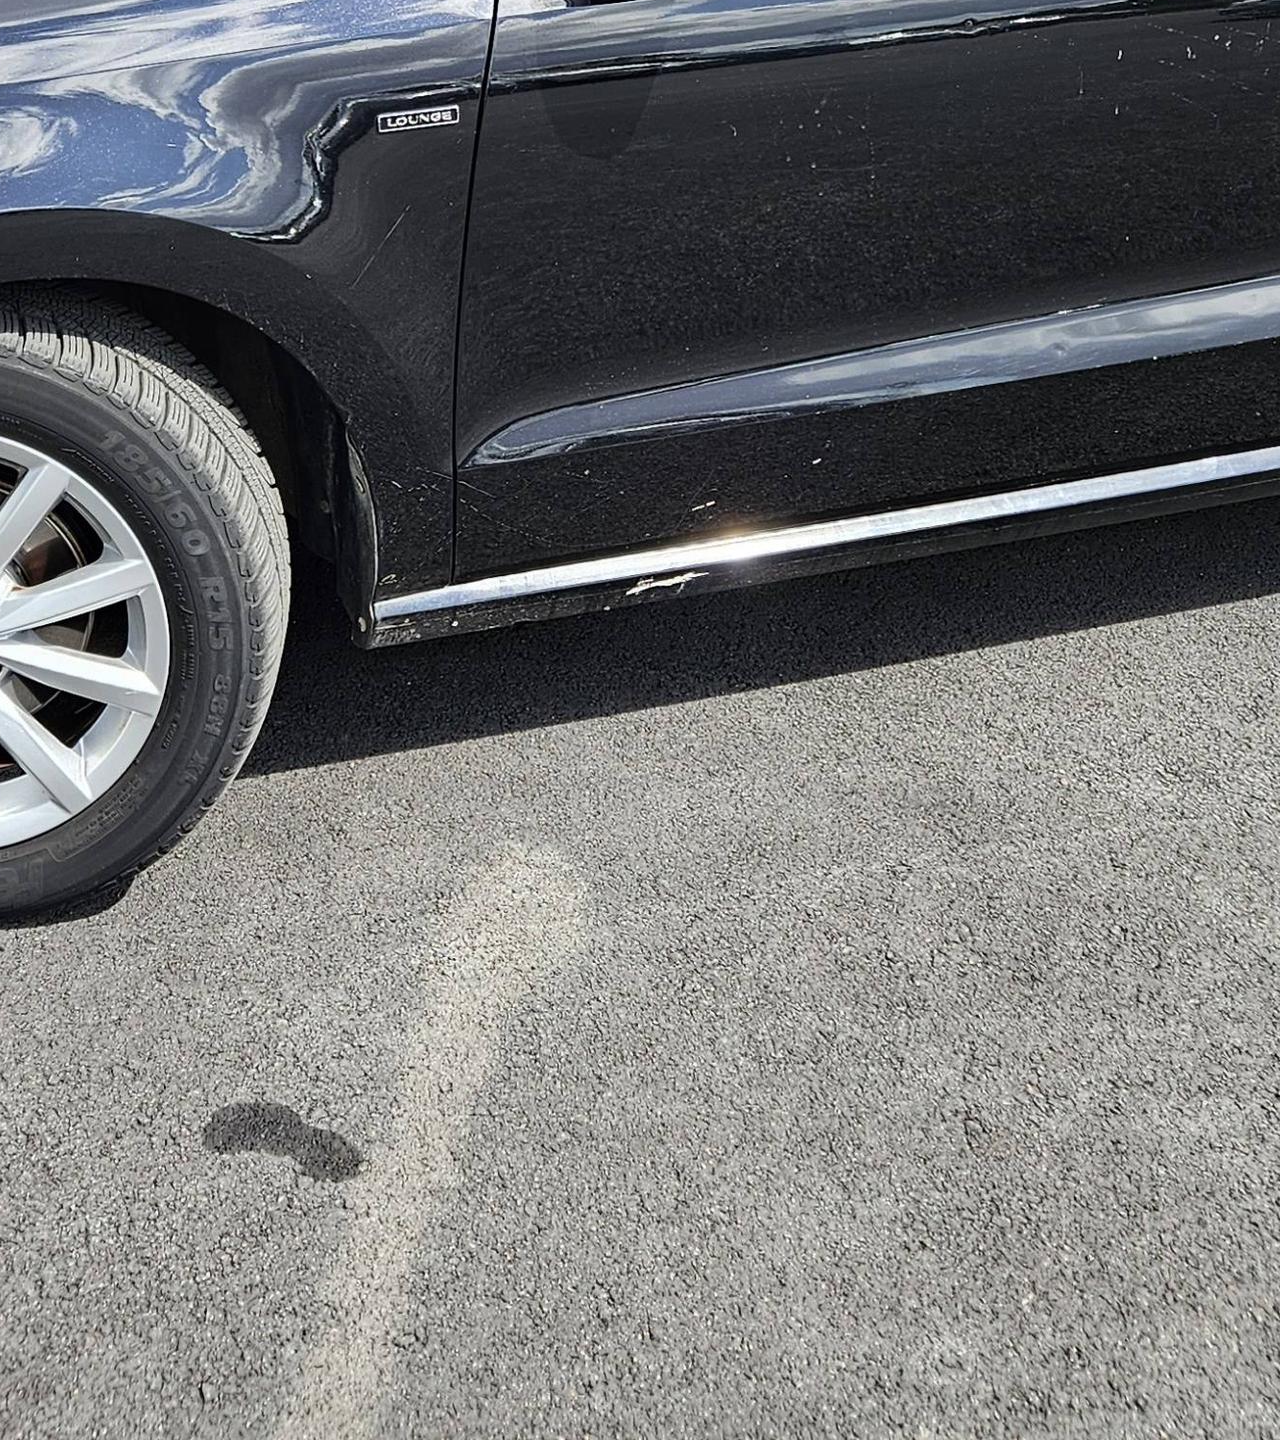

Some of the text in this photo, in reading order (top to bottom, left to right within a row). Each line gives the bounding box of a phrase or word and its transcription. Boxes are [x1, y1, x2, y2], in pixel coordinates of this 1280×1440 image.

[386, 110, 452, 128] LOUNGE
[99, 430, 212, 558] 185/60
[198, 575, 233, 653] R15
